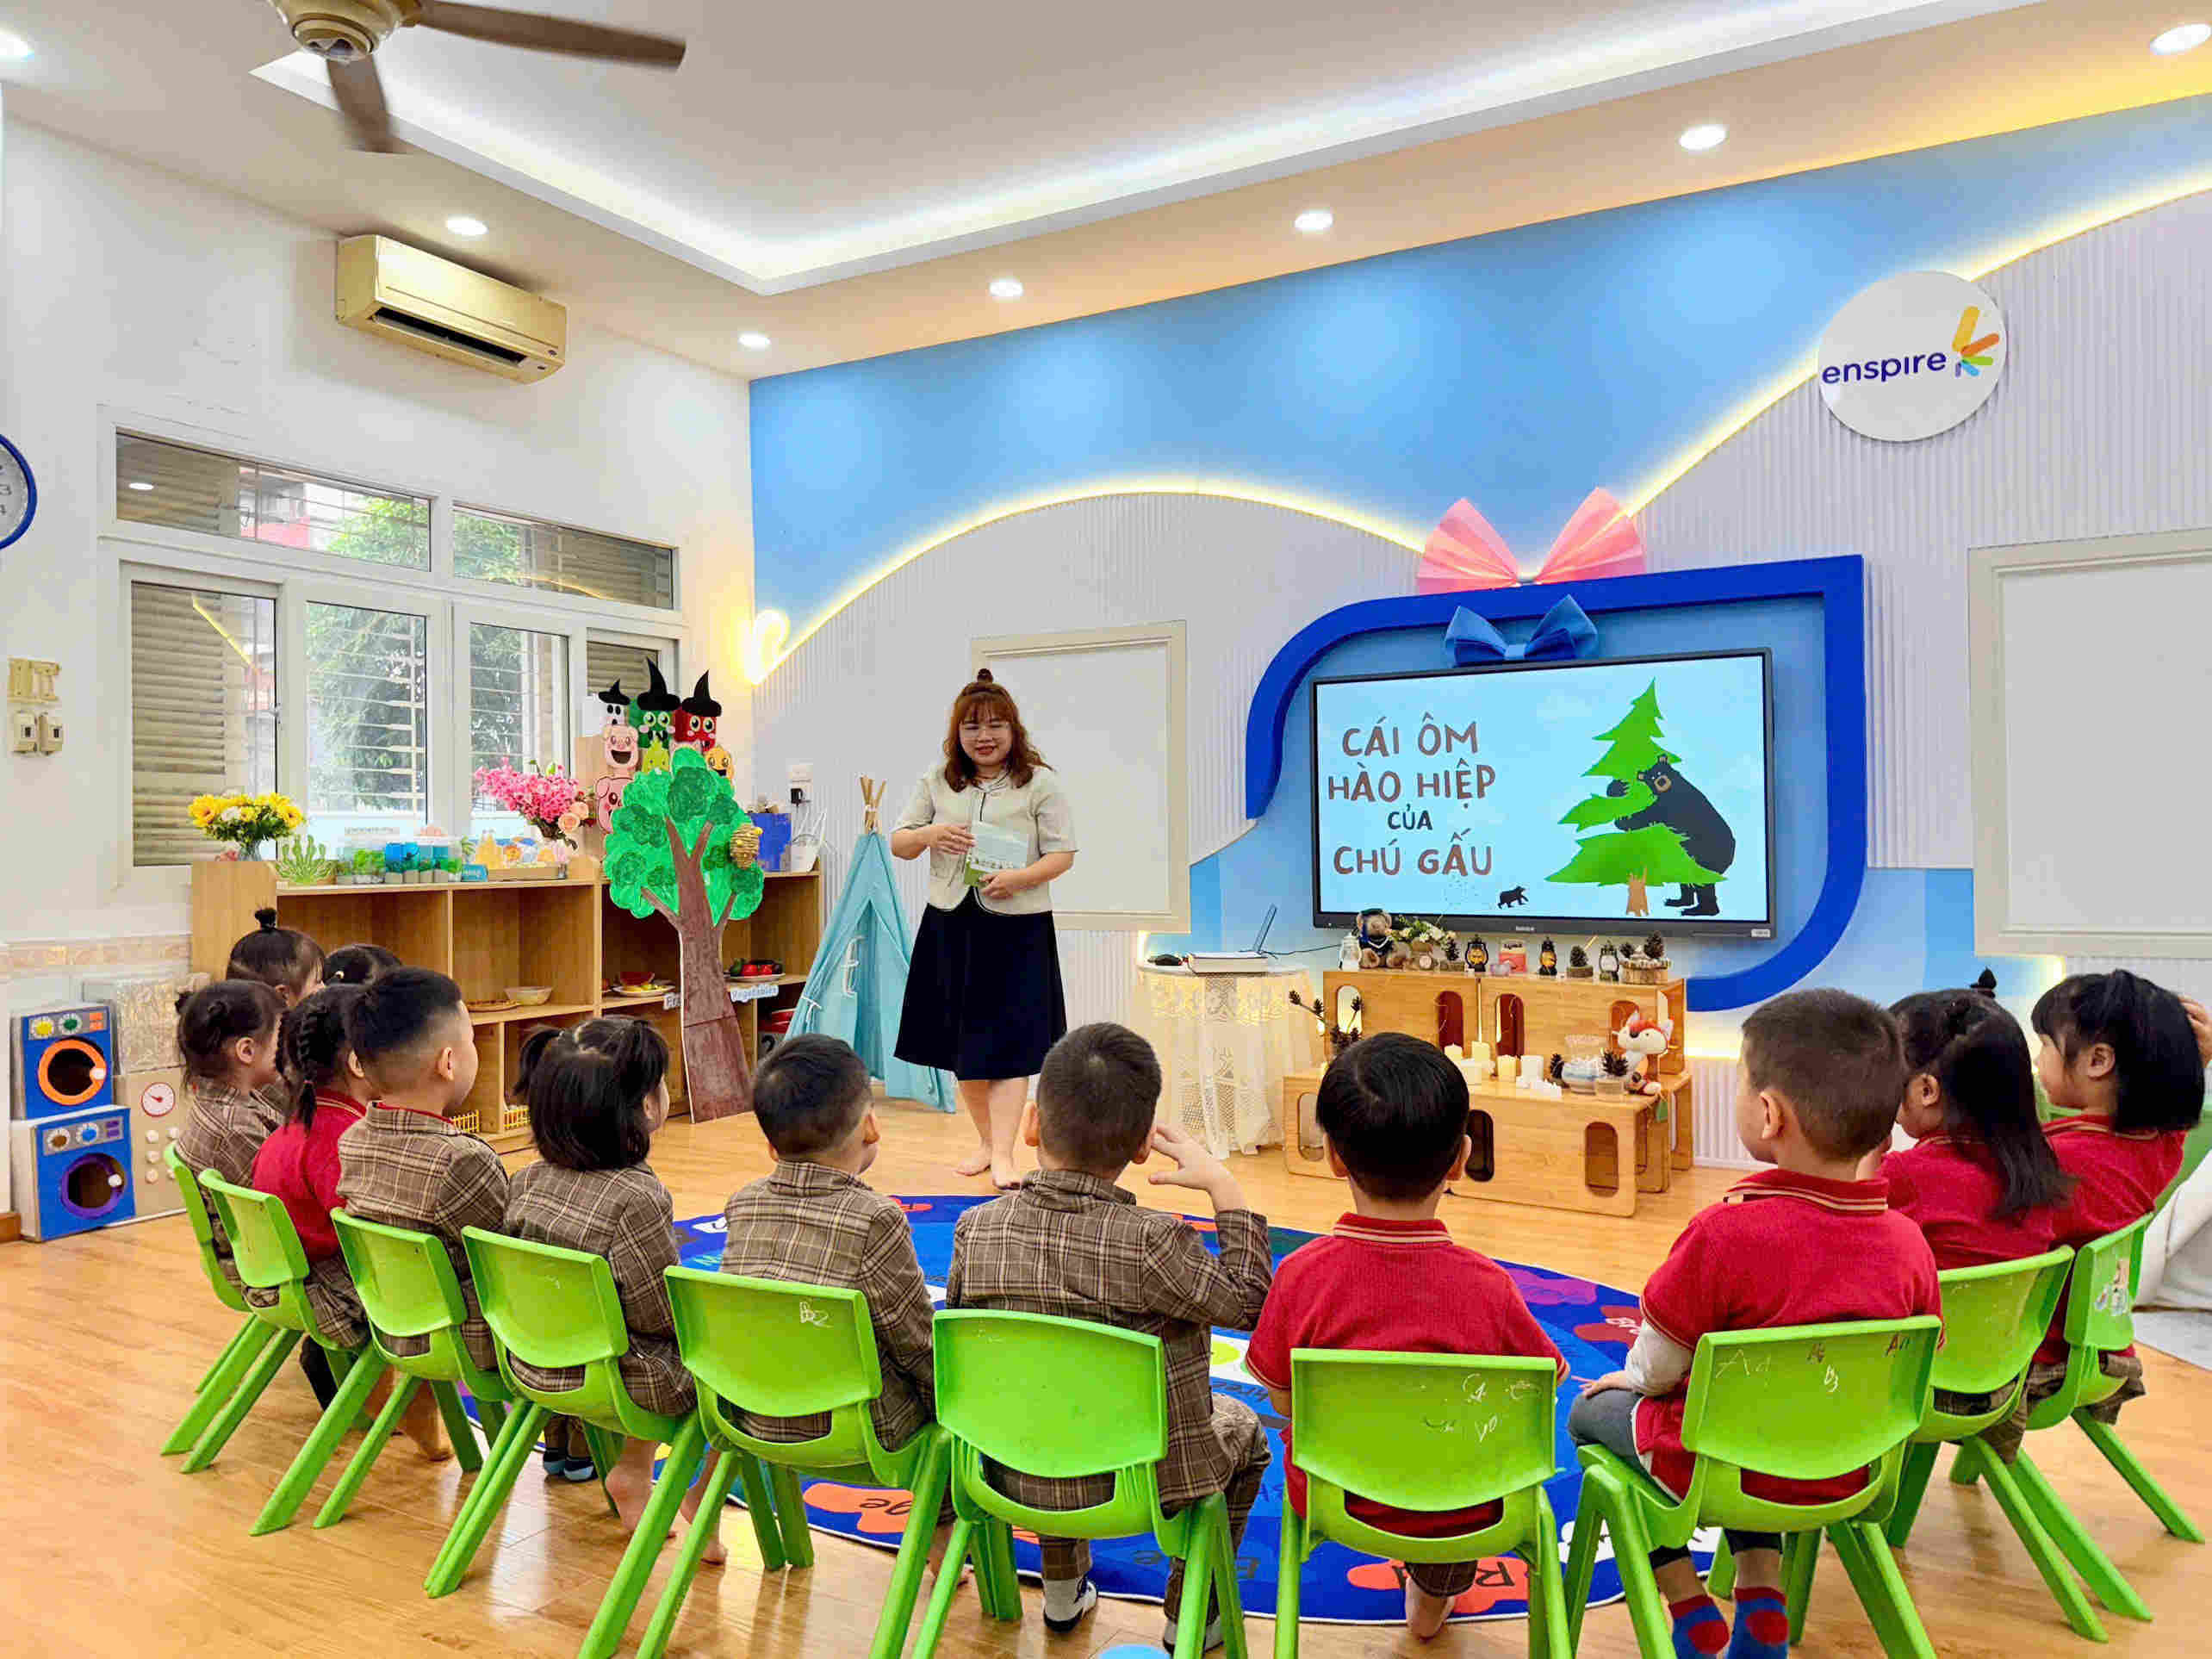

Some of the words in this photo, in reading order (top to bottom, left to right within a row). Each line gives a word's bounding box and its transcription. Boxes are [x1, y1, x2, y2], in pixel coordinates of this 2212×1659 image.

[1821, 351, 1948, 384] enspire
[1342, 716, 1400, 757] CÁI
[1417, 711, 1479, 756] ÔM
[1327, 761, 1401, 803] HÀO
[1416, 757, 1496, 809] HIỆP
[1387, 803, 1433, 830] CỦA
[1333, 838, 1401, 876] CHÚ
[1417, 827, 1492, 877] GẤU
